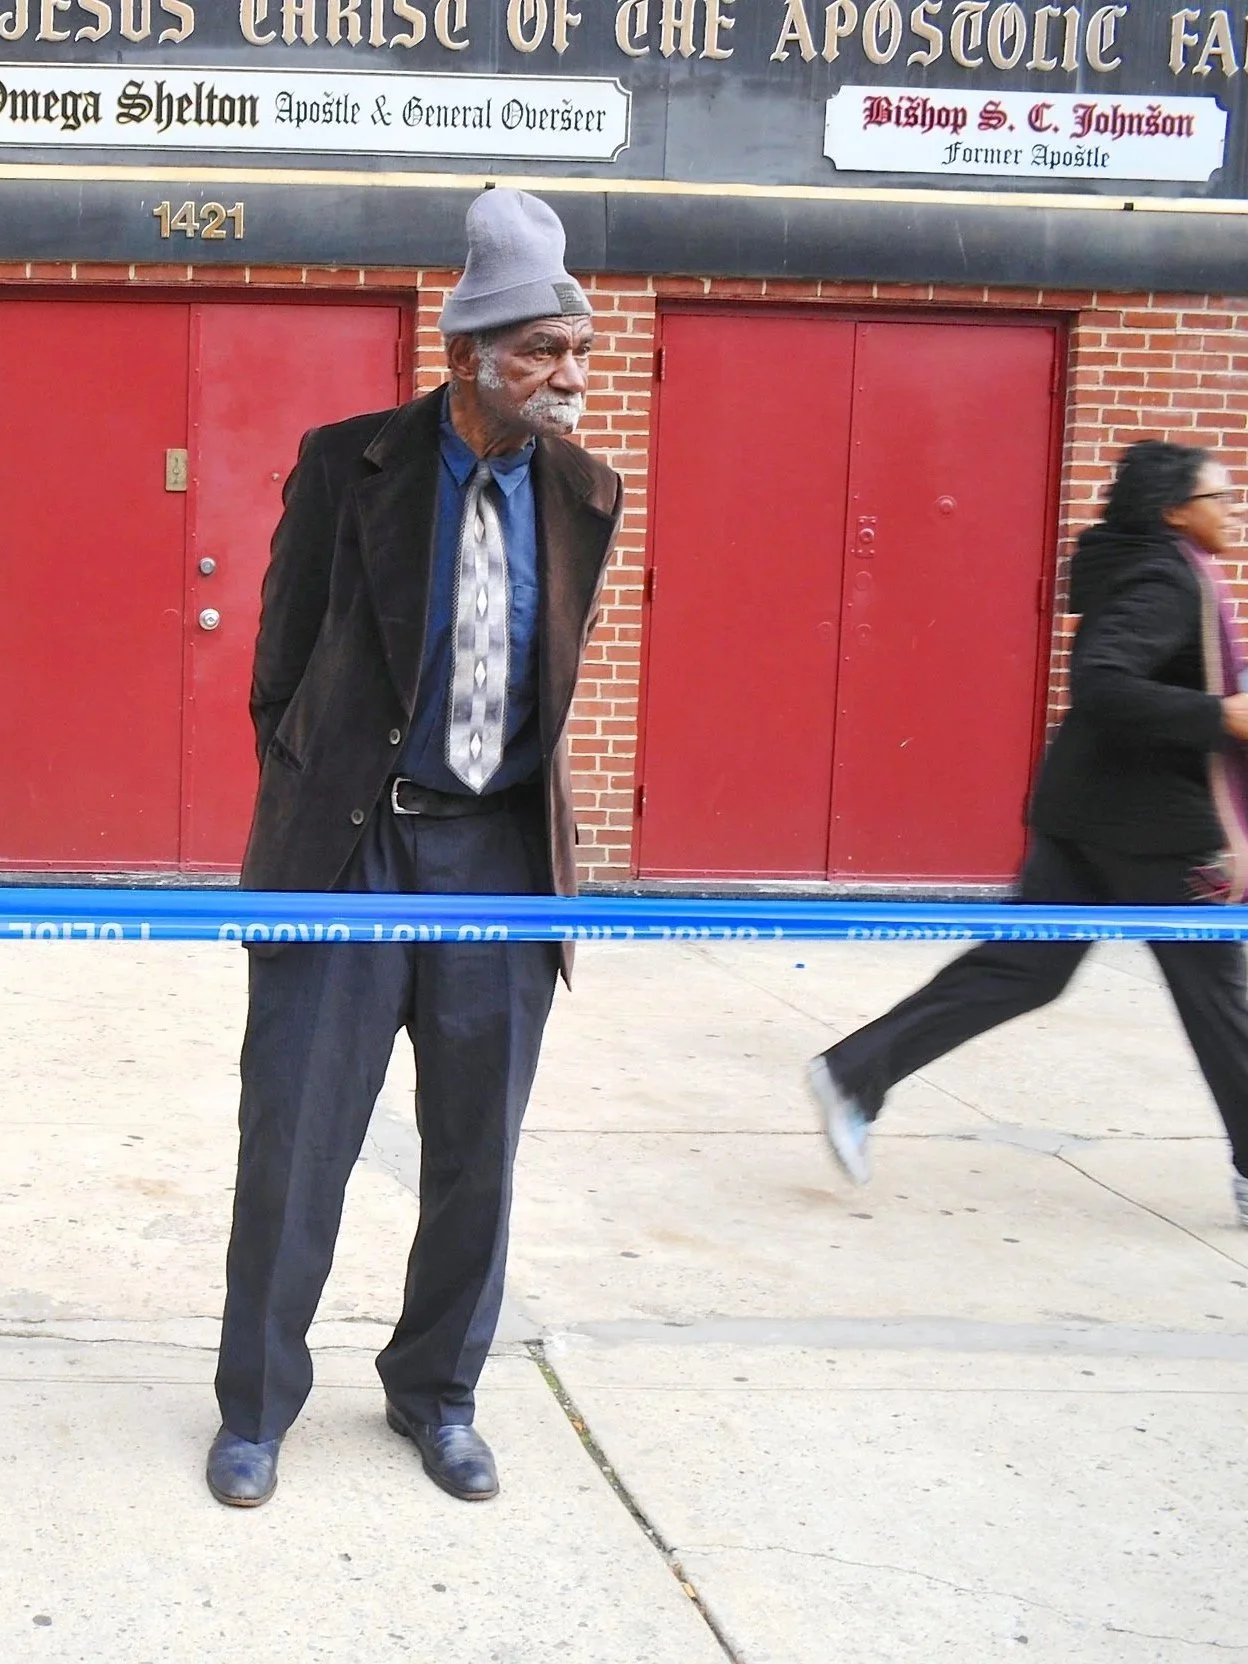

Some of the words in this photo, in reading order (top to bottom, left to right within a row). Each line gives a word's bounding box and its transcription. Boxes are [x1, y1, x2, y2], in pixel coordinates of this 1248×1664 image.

[239, 0, 470, 50] CHRIST
[507, 0, 582, 55] OF
[615, 0, 737, 59] THE
[769, 0, 1128, 73] APOSTOLIC
[1168, 8, 1248, 78] FA
[115, 80, 259, 134] Shelton
[274, 91, 361, 130] Apostle
[371, 95, 394, 126] &
[402, 97, 493, 130] General
[501, 98, 607, 134] Overseer
[862, 94, 969, 135] Bishop
[978, 101, 1016, 132] S.
[1027, 103, 1061, 134] C.
[1071, 102, 1196, 140] Johnson
[941, 141, 1024, 167] Former
[1031, 144, 1110, 170] Apostle
[152, 200, 246, 241] 1421
